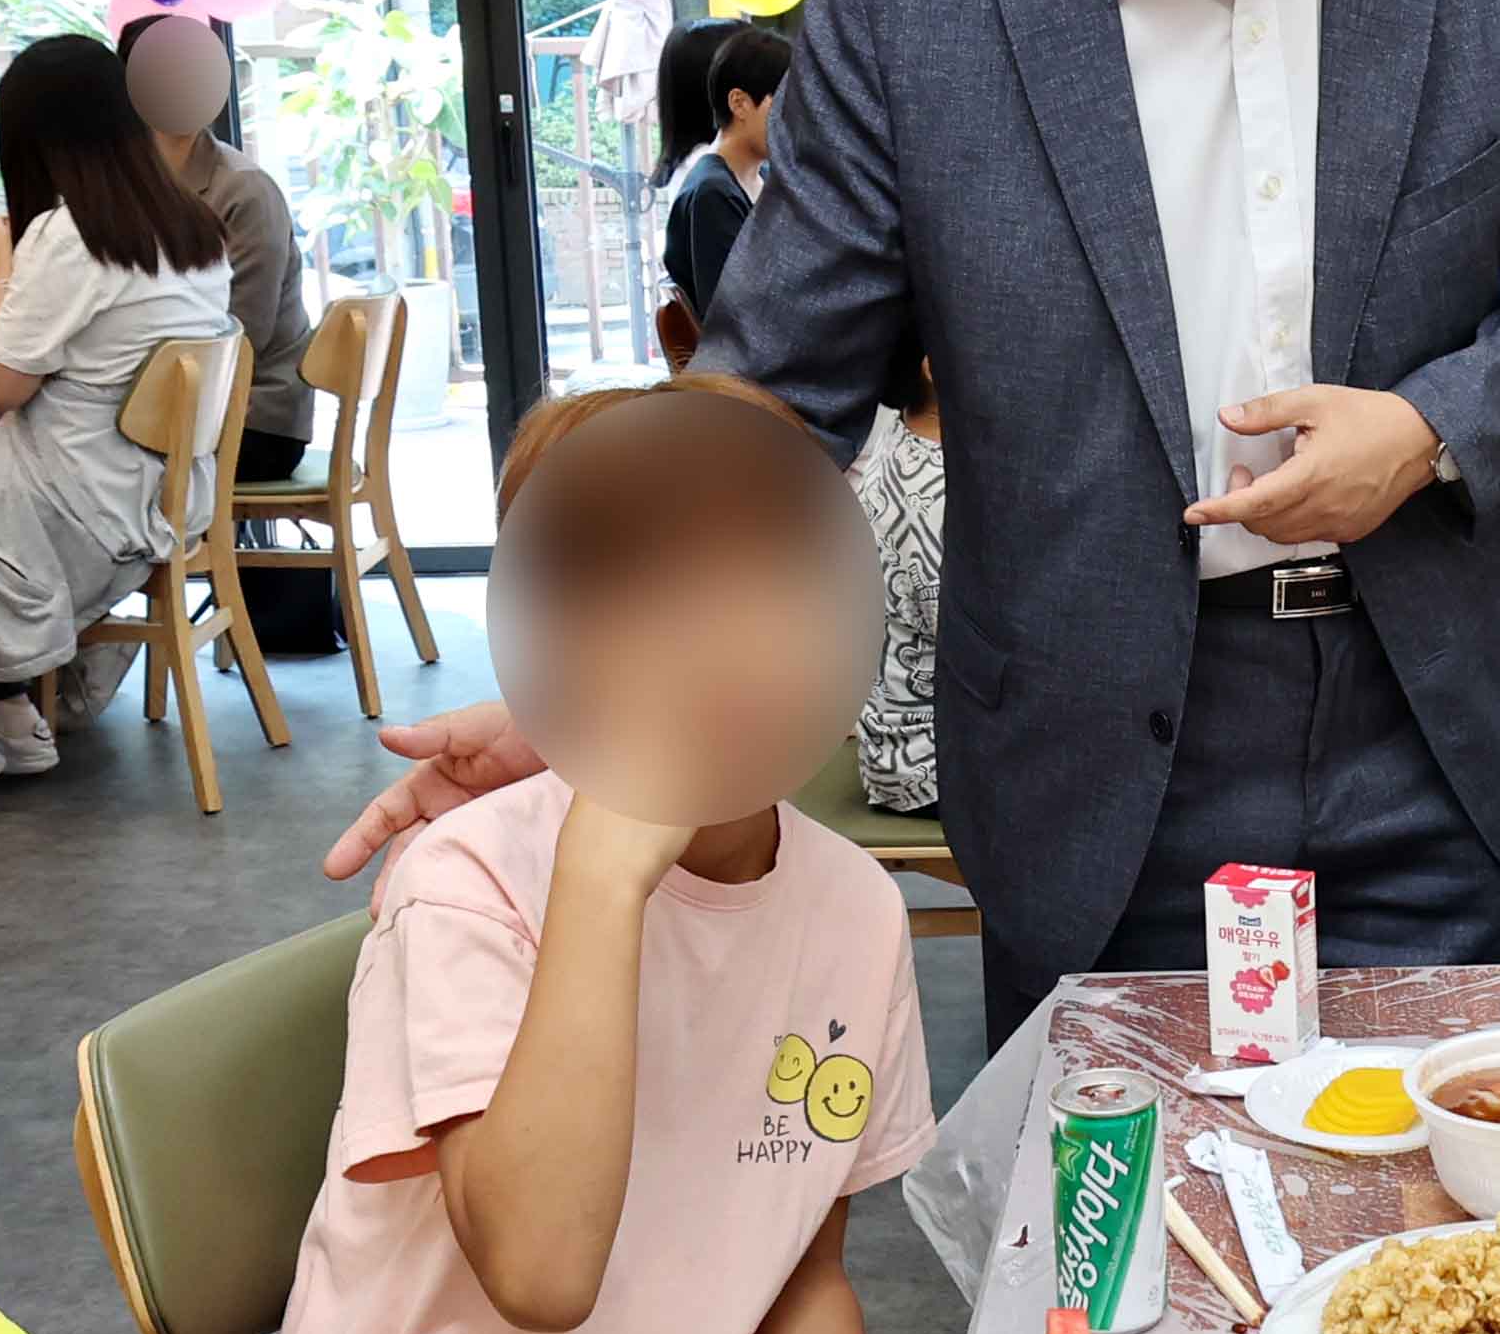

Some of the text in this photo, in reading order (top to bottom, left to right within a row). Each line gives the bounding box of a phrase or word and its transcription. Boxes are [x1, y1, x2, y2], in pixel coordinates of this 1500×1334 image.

[1218, 927, 1281, 949] 매일우유
[764, 1115, 790, 1136] BE
[737, 1139, 813, 1164] HAPPY
